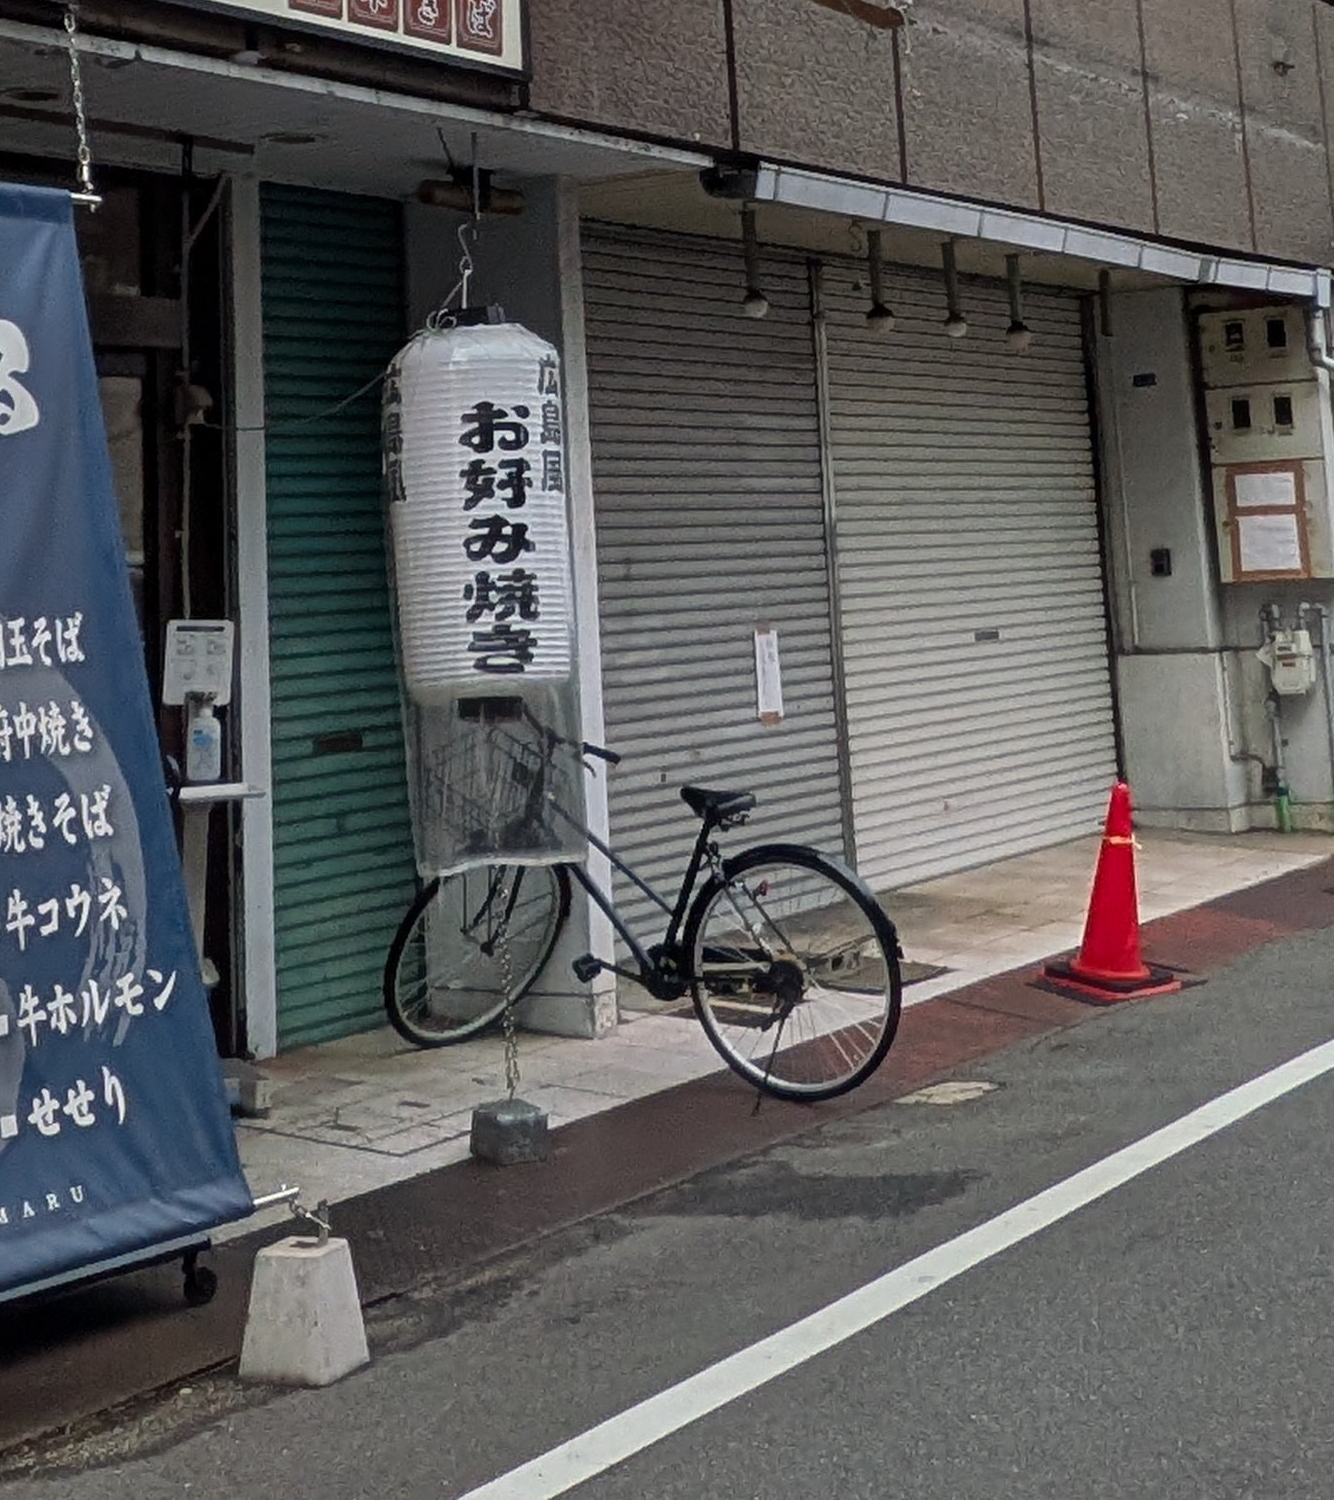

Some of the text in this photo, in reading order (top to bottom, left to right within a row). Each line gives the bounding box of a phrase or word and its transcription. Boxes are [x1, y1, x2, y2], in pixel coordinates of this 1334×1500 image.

[458, 401, 541, 674] お好み焼き
[6, 878, 127, 952] 牛コウネ
[15, 968, 176, 1048] 牛ホルモン
[28, 1066, 128, 1138] せせり
